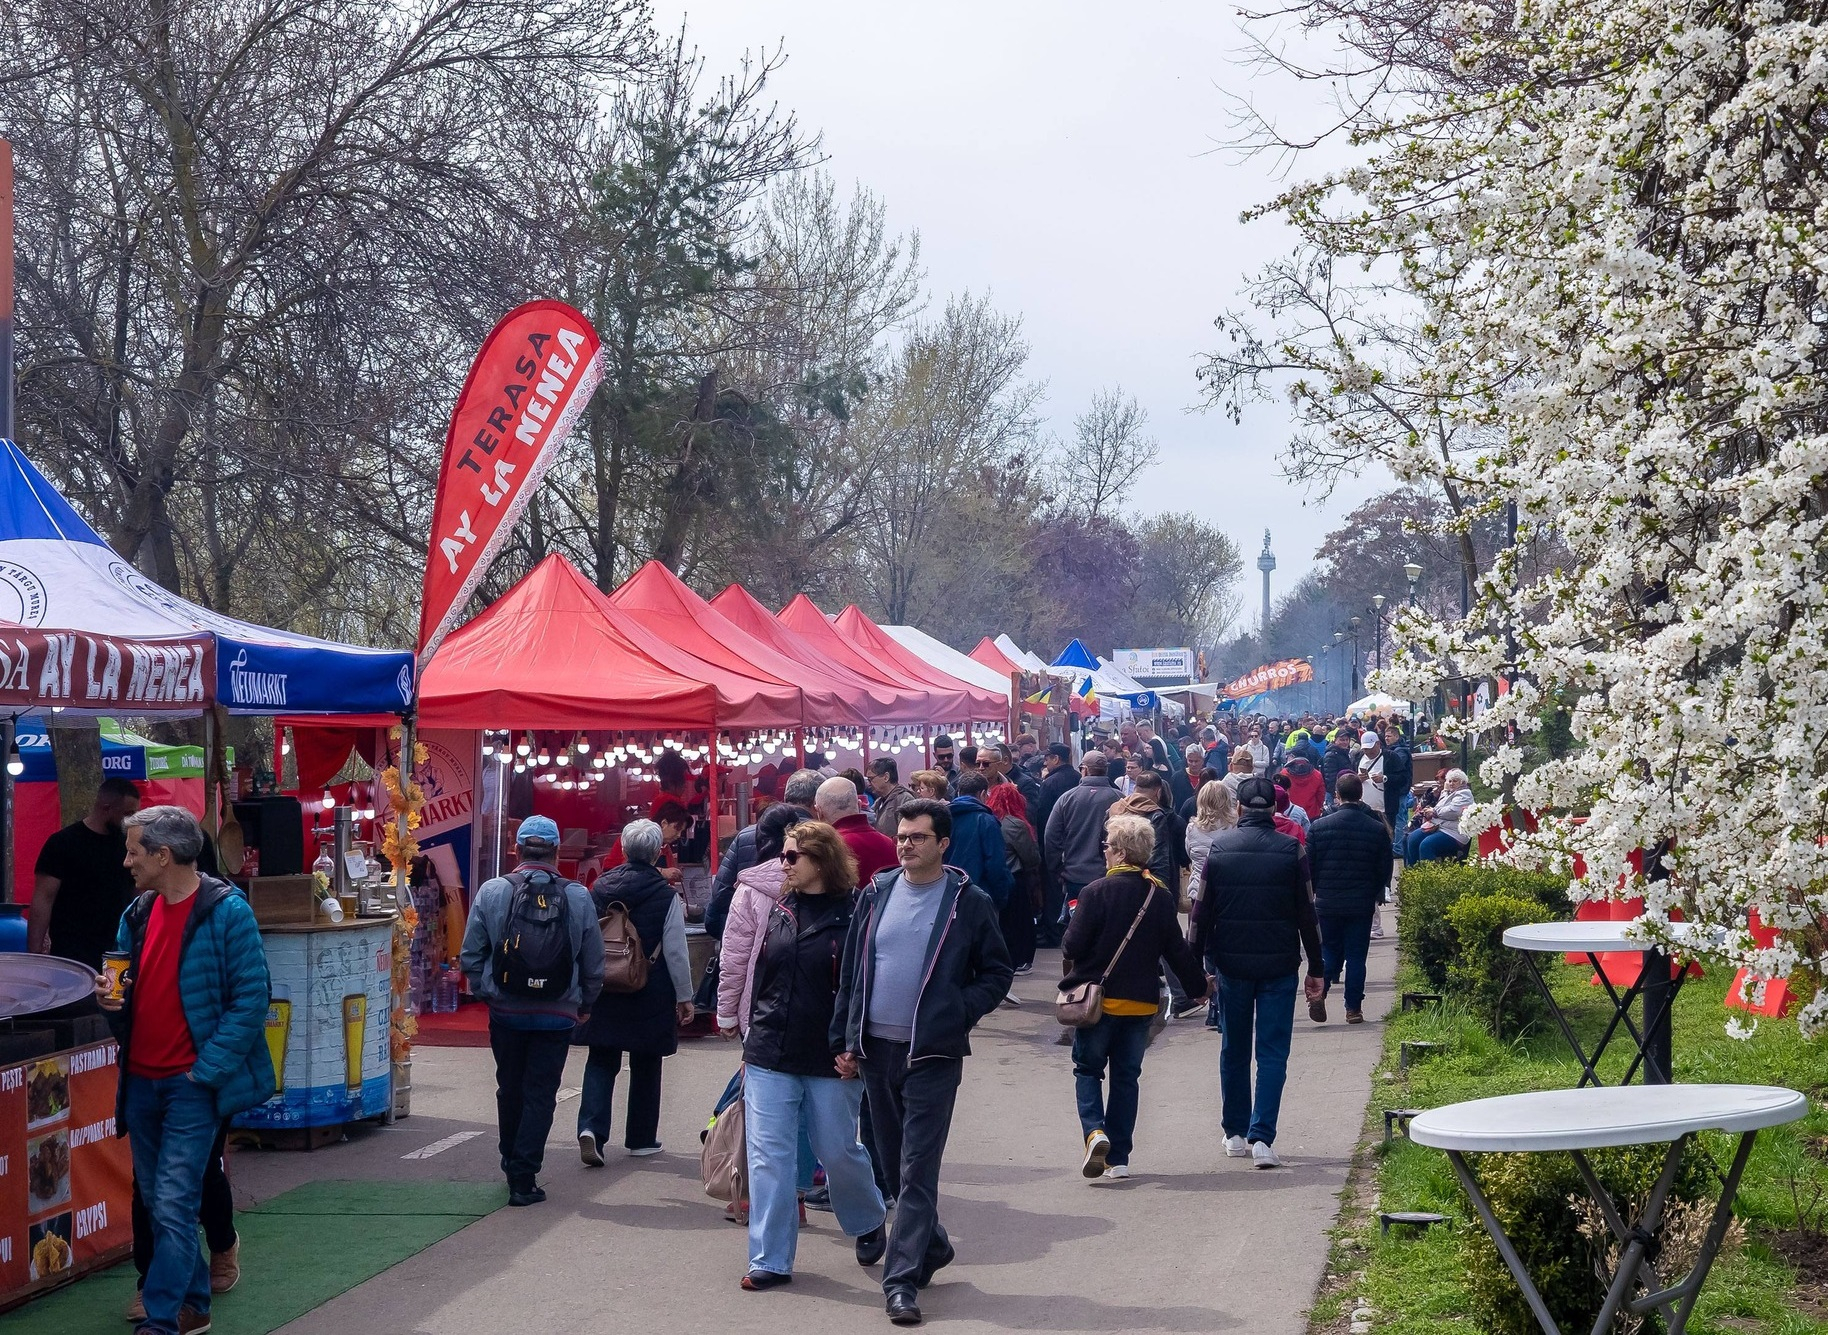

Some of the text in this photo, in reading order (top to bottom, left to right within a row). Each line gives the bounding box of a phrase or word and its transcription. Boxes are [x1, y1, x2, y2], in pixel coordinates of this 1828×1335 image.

[457, 331, 551, 474] TERASA
[439, 327, 585, 575] AY LA NENEA
[38, 633, 76, 698] AY
[85, 636, 122, 700] LA
[124, 643, 205, 702] NENEA
[229, 648, 288, 705] NEUMARKT
[1230, 663, 1297, 691] CHURROS
[102, 755, 131, 770] ORG
[527, 977, 545, 989] CAT
[107, 1045, 116, 1066] DE
[1, 1066, 23, 1095] PEȘTE
[76, 1200, 107, 1240] CRYPSI
